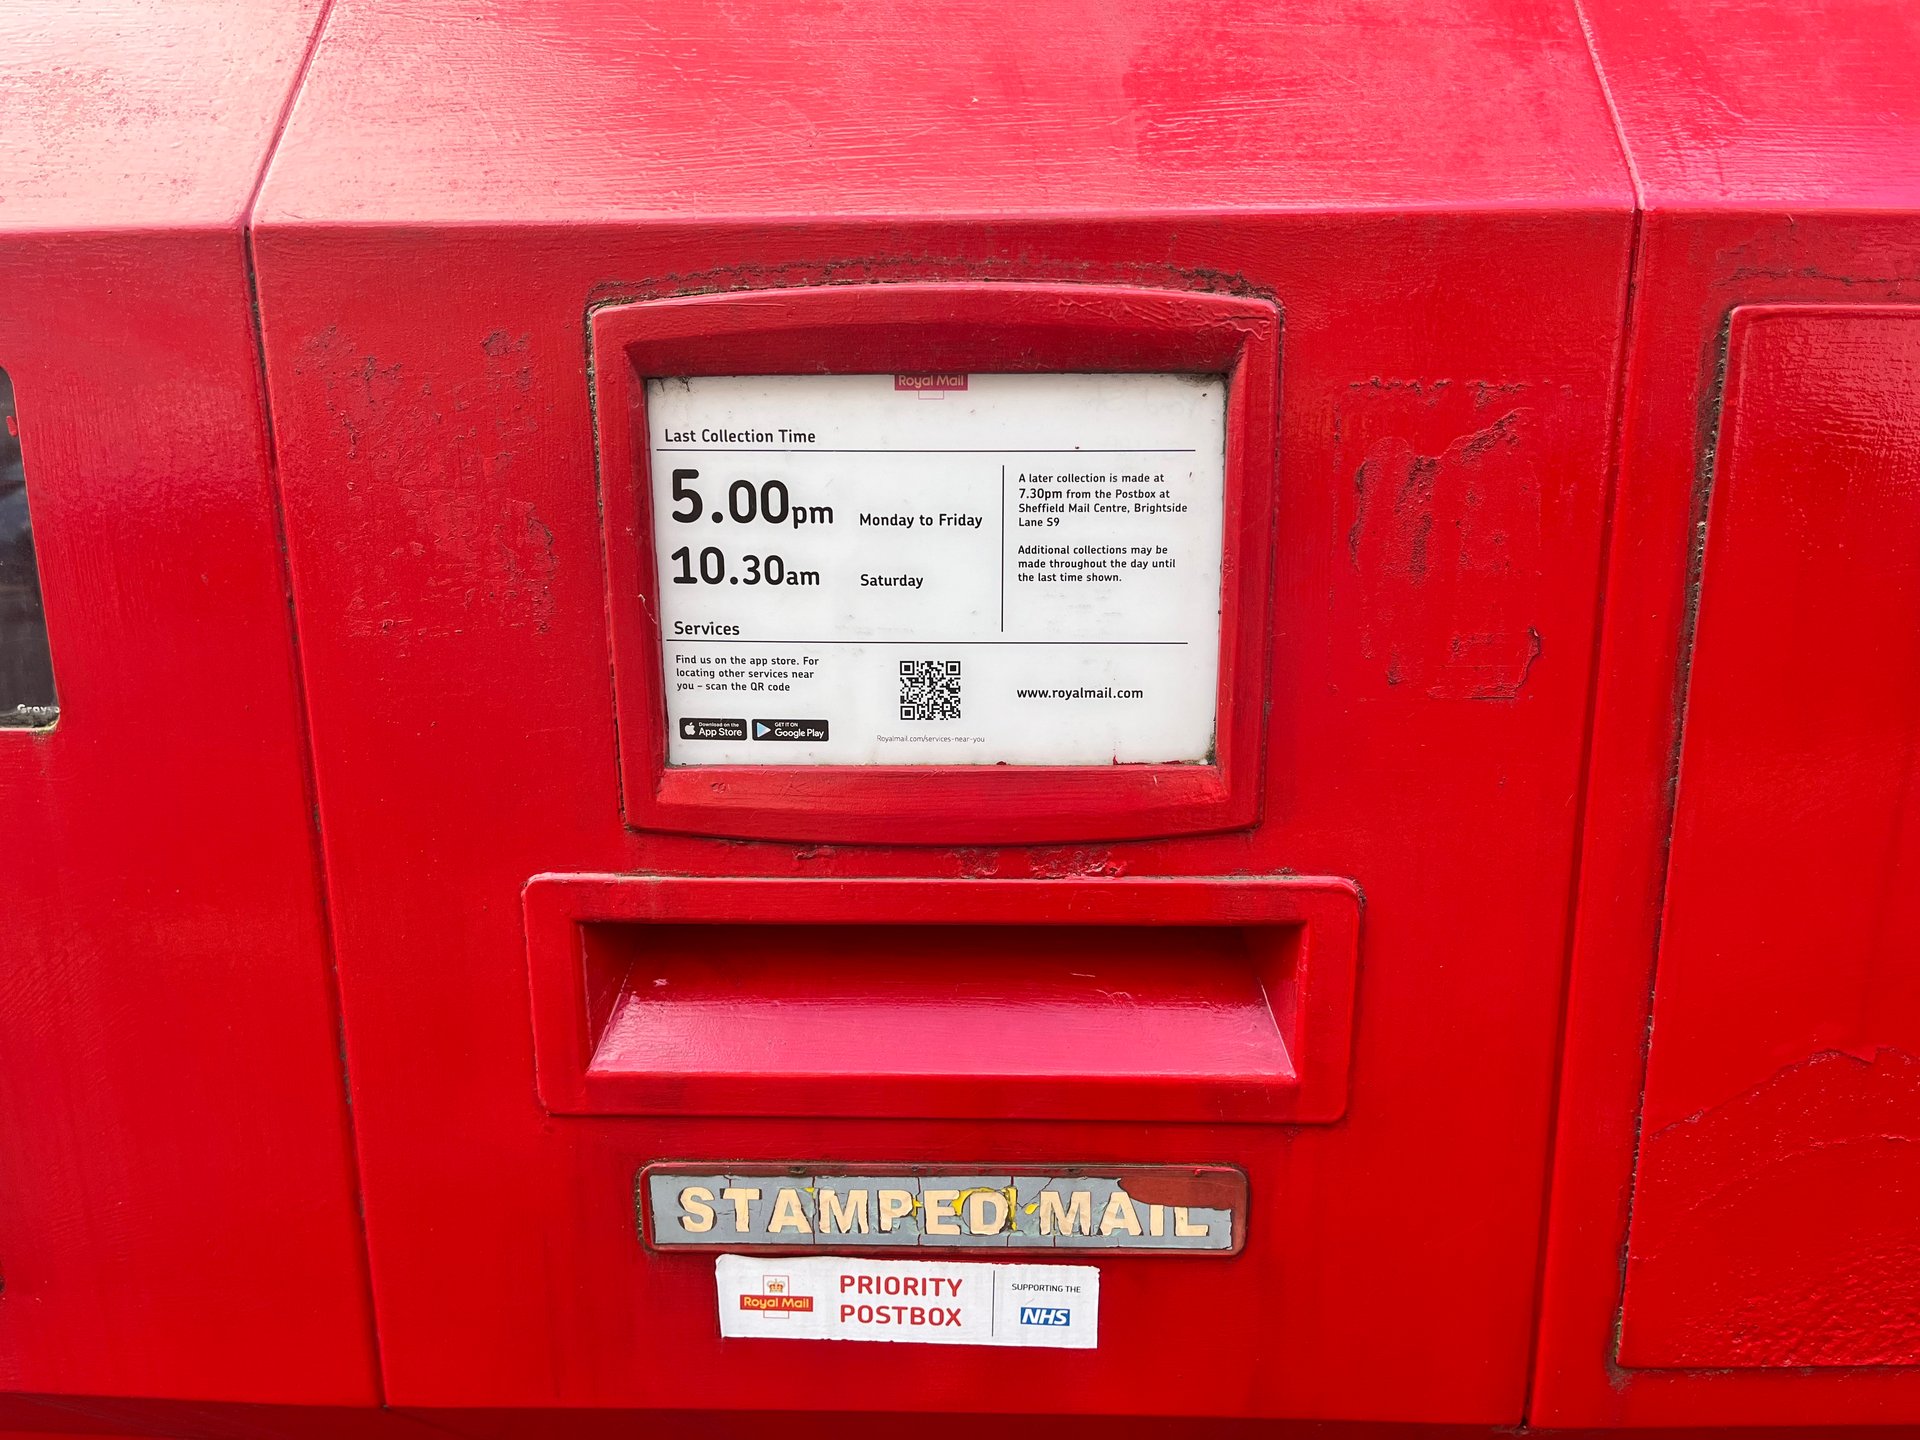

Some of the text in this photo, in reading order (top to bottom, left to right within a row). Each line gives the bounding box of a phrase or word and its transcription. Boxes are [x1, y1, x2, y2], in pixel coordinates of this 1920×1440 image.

[899, 375, 964, 388] Royal Mail
[665, 429, 815, 443] Last Collection Time
[1018, 473, 1164, 483] A later collection is made at
[671, 468, 983, 530] 5.00pm Monday to Friday
[1018, 488, 1170, 502] 7.30pm from the Postbox at
[1018, 503, 1188, 515] Sheffield Mail Centre, Brightside
[1018, 517, 1060, 527] Lane S9
[1018, 545, 1168, 558] Additional collections may be
[671, 546, 924, 590] 10.30am Saturday
[1018, 559, 1176, 571] made throughout the day until
[1018, 572, 1122, 582] the last time shown.
[674, 621, 740, 637] Services
[676, 655, 820, 667] Find us on the app store. For
[676, 668, 815, 679] locating other services near
[677, 683, 694, 692] you
[706, 682, 728, 691] scan
[731, 682, 747, 691] the
[750, 682, 765, 692] QR
[768, 682, 791, 692] code
[1017, 686, 1144, 701] www.royalmail.com
[699, 727, 743, 737] App Store
[774, 728, 824, 739] Google Play
[877, 734, 985, 744] Royalmail.com/services-near-you
[679, 1186, 1209, 1237] STAMPED MAIL
[840, 1275, 963, 1298] PRIORITY
[1011, 1283, 1081, 1293] SUPPORTING THE
[744, 1296, 809, 1309] Royal Mail
[840, 1304, 962, 1327] POSTBOX
[1021, 1308, 1069, 1325] NHS
